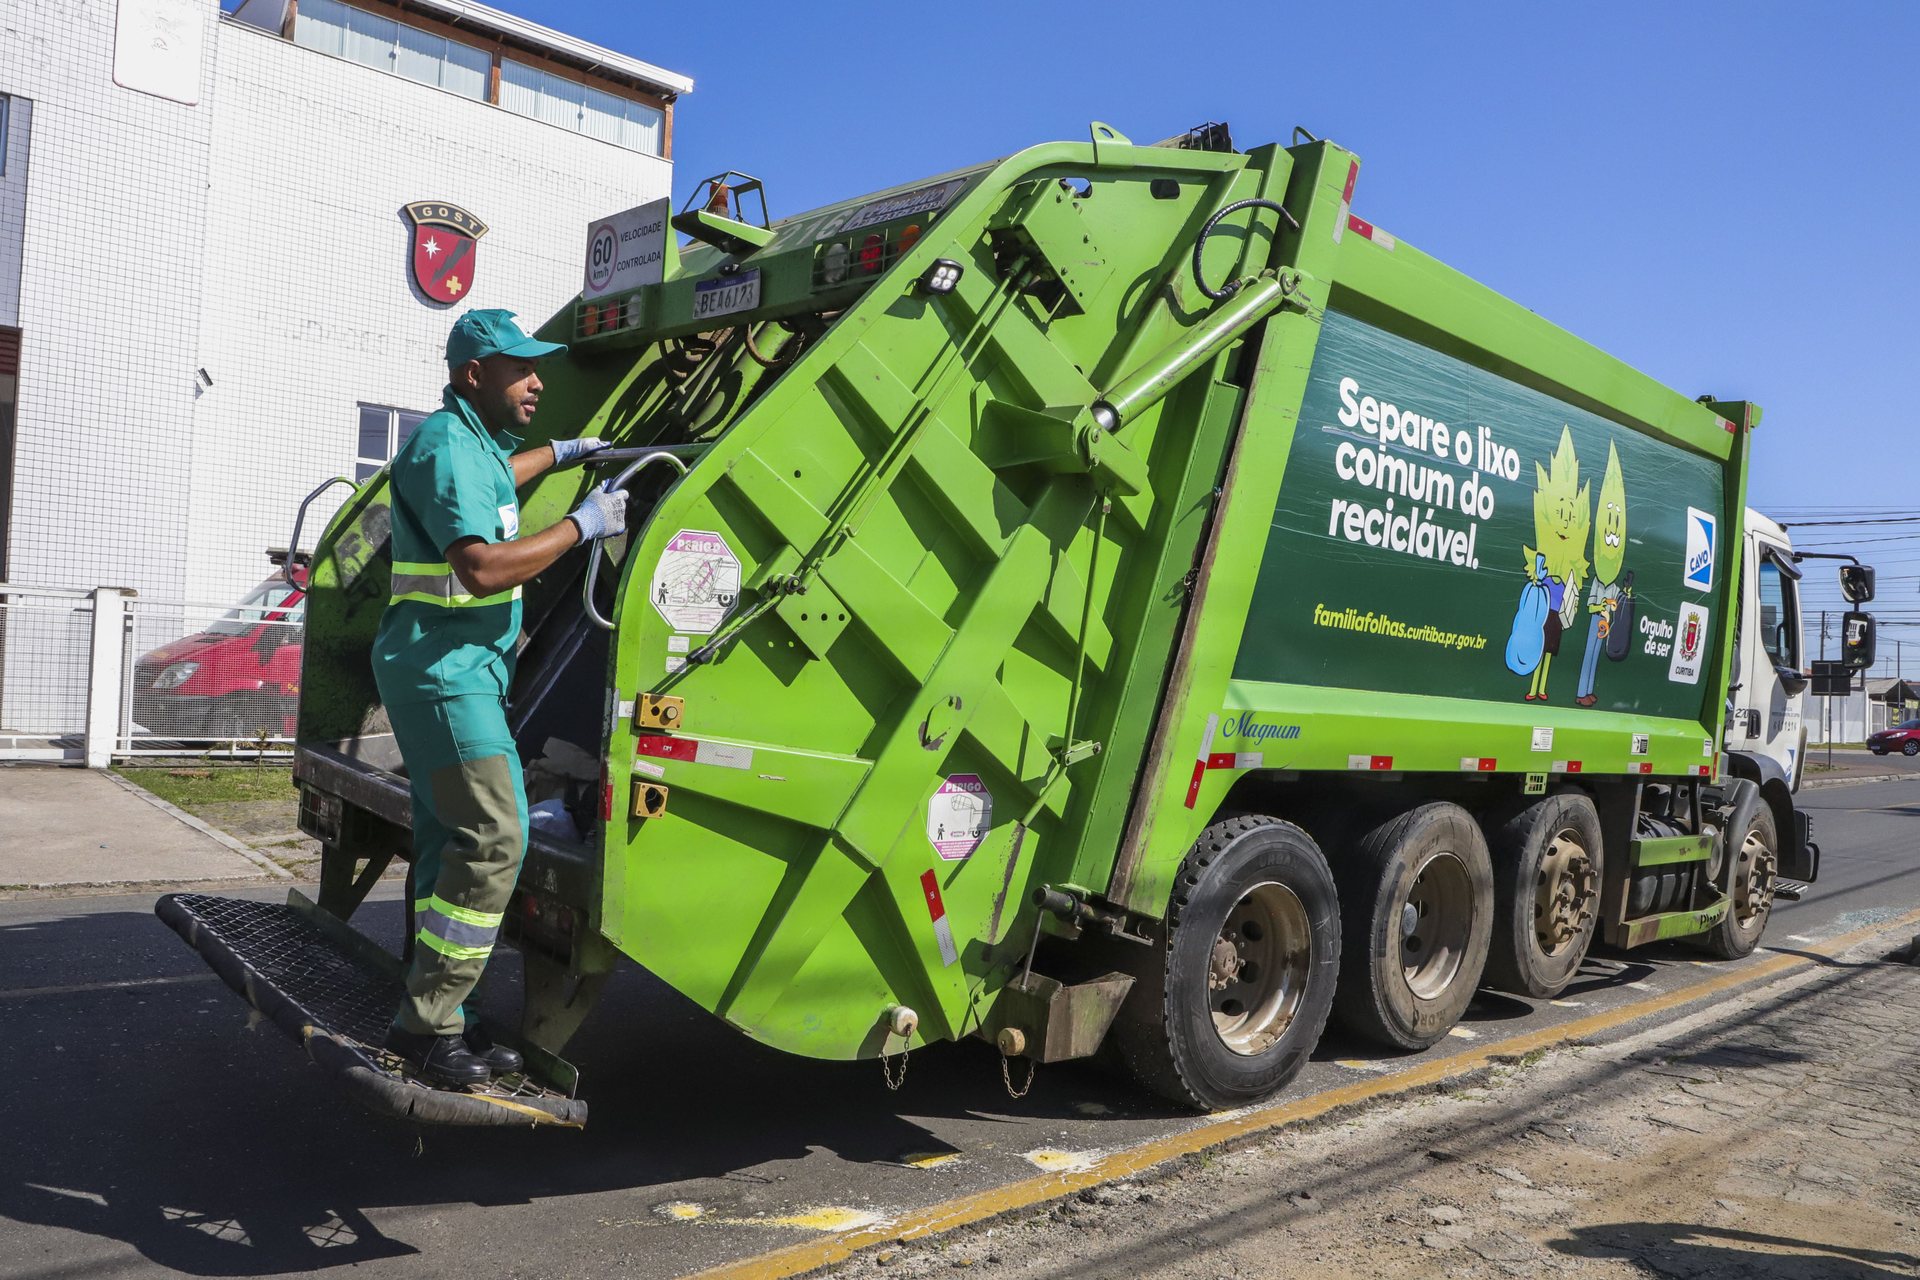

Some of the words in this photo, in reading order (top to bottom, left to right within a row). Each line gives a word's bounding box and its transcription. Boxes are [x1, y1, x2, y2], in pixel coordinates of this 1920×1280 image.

[422, 207, 478, 230] GOST
[620, 221, 662, 243] VELOCIDADE
[593, 236, 612, 267] 60
[616, 251, 662, 272] CONTROLADA
[592, 267, 609, 281] km/h
[1338, 377, 1450, 458] Separe
[1455, 430, 1473, 465] o
[1477, 425, 1520, 481] lixo
[1335, 441, 1455, 509] comum
[1459, 471, 1494, 520] do
[1328, 497, 1479, 570] reciclável.
[676, 539, 722, 554] PERIGO
[1690, 550, 1708, 573] CAVO
[1313, 603, 1487, 650] familiafolhas.curitiba.pr.gov.br
[1640, 615, 1673, 640] Orgulho
[1644, 638, 1656, 655] de
[1656, 643, 1671, 657] ser
[1675, 666, 1695, 677] CURITIBA
[1222, 711, 1300, 746] Magnum
[945, 782, 982, 793] PERIGO
